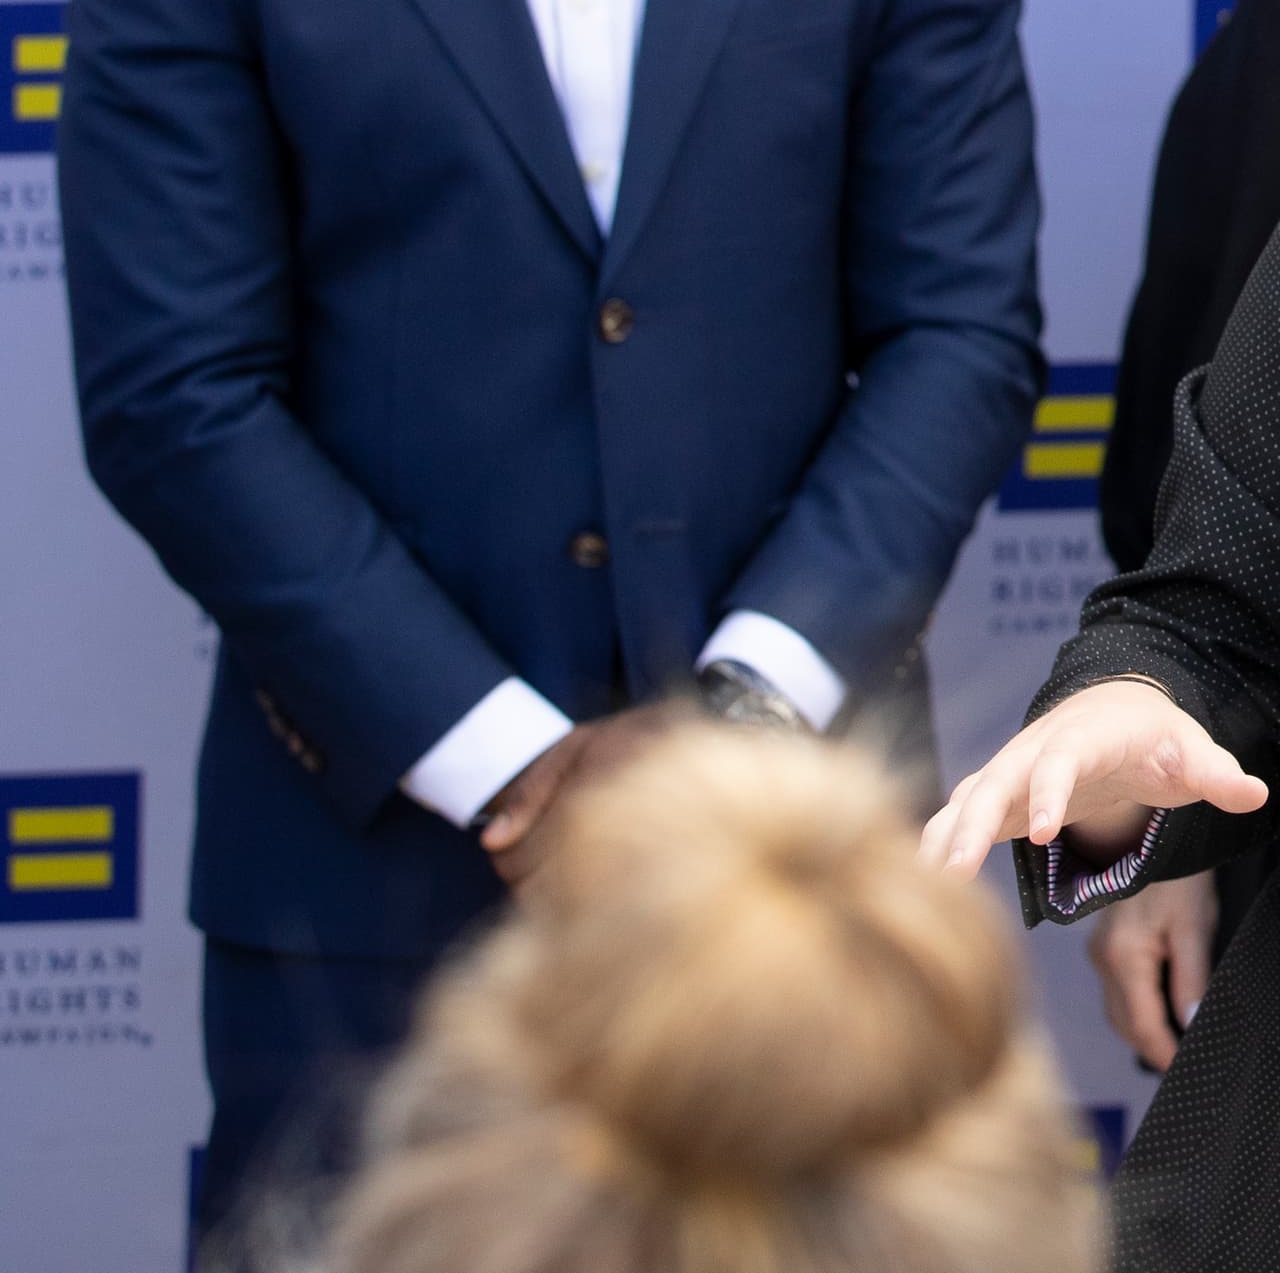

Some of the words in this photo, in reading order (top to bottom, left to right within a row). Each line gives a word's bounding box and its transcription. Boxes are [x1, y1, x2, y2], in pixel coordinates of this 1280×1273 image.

[990, 535, 1091, 565] HUM
[0, 947, 142, 977] UMAN
[7, 984, 141, 1015] IGHTS
